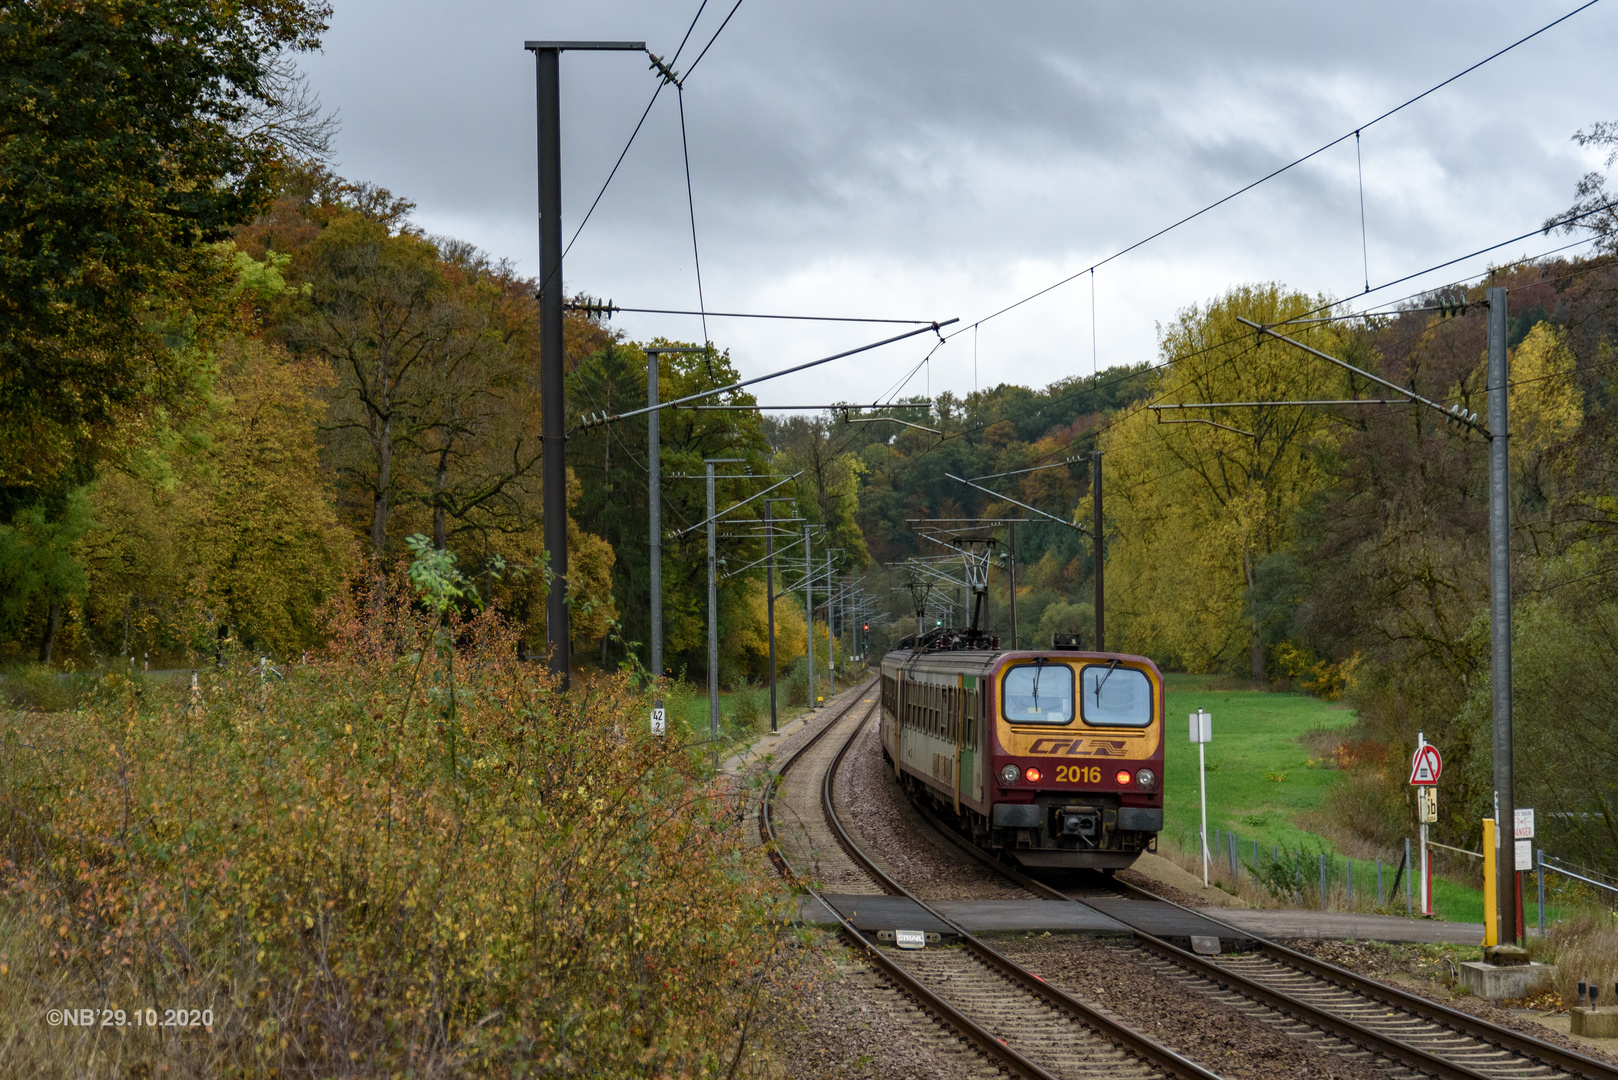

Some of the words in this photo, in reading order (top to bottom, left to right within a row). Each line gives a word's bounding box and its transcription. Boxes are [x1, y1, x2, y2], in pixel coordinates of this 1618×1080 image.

[653, 711, 662, 720] 42
[1028, 738, 1093, 755] CFL
[1055, 765, 1102, 783] 2016
[1514, 826, 1532, 836] ANGER
